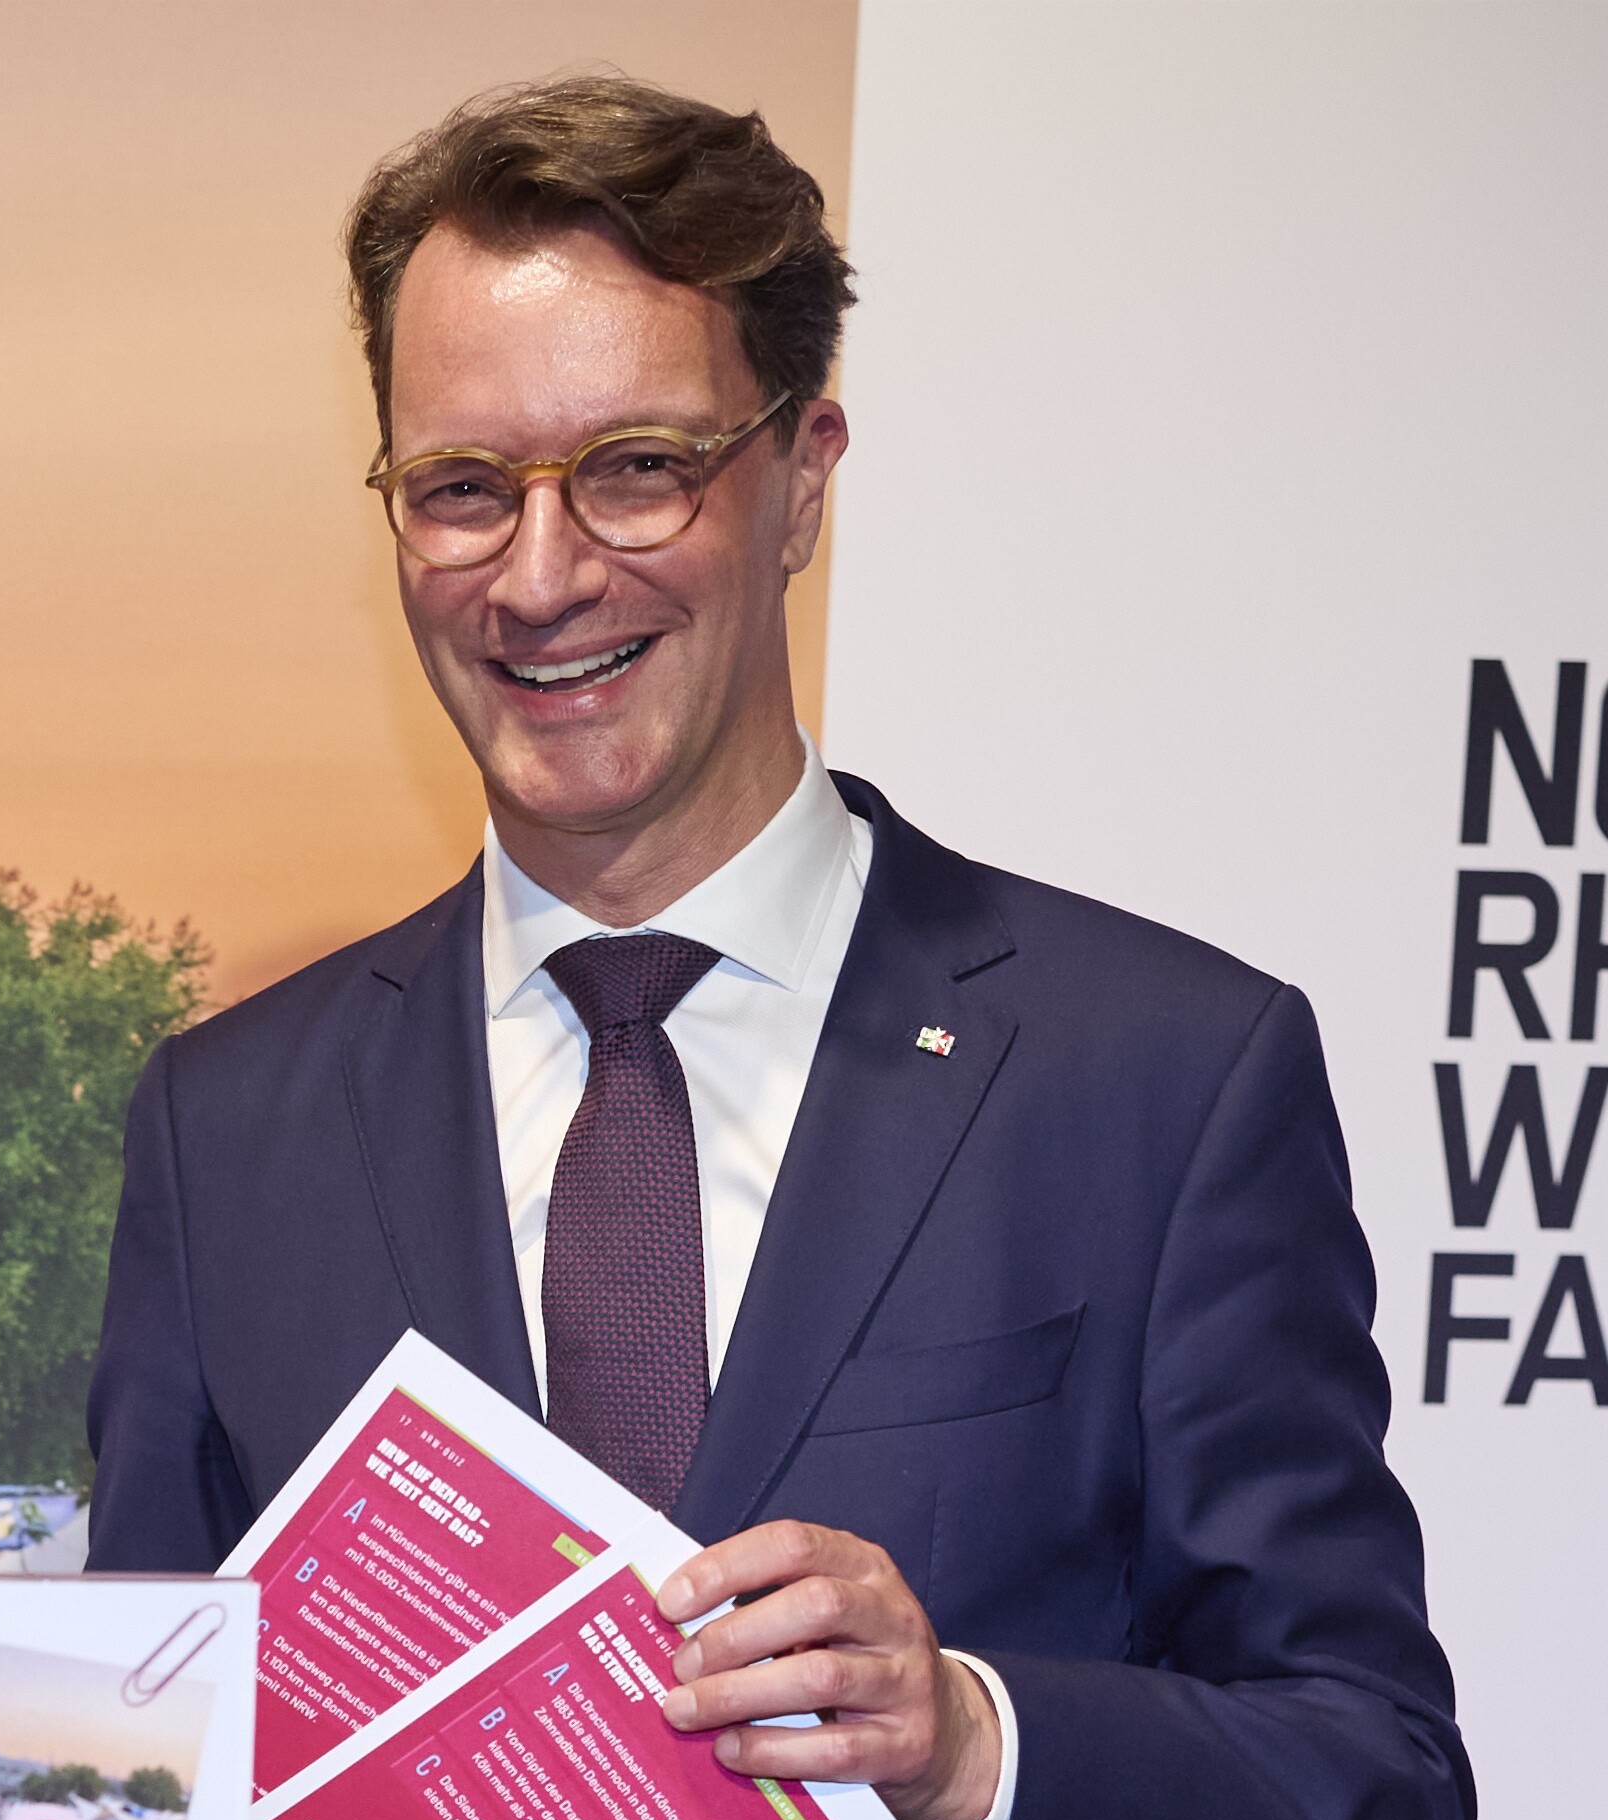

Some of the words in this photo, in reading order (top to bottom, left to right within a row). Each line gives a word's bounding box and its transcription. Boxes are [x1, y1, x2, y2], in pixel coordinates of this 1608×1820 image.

[1460, 658, 1608, 848] N
[365, 1453, 392, 1479] WIE
[388, 1470, 423, 1501] WEIT
[417, 1494, 453, 1524] GEHT
[447, 1516, 483, 1547] DAS?
[376, 1437, 409, 1466] NRW
[403, 1459, 433, 1483] AUF
[427, 1476, 458, 1504] DEM
[452, 1495, 481, 1521] RAD
[342, 1497, 366, 1523] A
[370, 1513, 386, 1530] Im
[384, 1524, 448, 1576] Münsterland
[444, 1572, 468, 1592] gibt
[466, 1588, 481, 1602] es
[479, 1598, 497, 1615] ein
[344, 1547, 365, 1565] mit
[363, 1559, 399, 1590] 15.000
[357, 1531, 442, 1599] ausgeschildertes
[440, 1593, 484, 1630] Radnetz
[294, 1556, 318, 1582] B
[321, 1574, 341, 1593] Die
[339, 1587, 427, 1659] NiederRheinroute
[425, 1653, 441, 1670] ist
[297, 1604, 379, 1672] Radwanderroute
[309, 1589, 327, 1608] km
[326, 1604, 344, 1620] die
[342, 1614, 381, 1648] längste
[592, 1610, 619, 1639] DER
[261, 1650, 289, 1674] 1.100
[286, 1669, 304, 1687] km
[303, 1683, 322, 1702] von
[321, 1696, 349, 1722] Bonn
[273, 1635, 294, 1654] Der
[291, 1649, 332, 1686] Radweg
[577, 1622, 605, 1654] WAS
[598, 1650, 644, 1702] STIMMT?
[278, 1687, 290, 1700] in
[289, 1695, 318, 1722] NRW.
[533, 1705, 587, 1773] Zahnradbahn
[542, 1662, 569, 1686] A
[566, 1681, 584, 1702] Die
[580, 1699, 647, 1783] Drachenfelsbahn
[643, 1780, 655, 1794] in
[415, 1754, 441, 1776] C
[438, 1774, 457, 1797] Das
[471, 1751, 492, 1777] Köln
[489, 1775, 513, 1802] mehr
[509, 1802, 525, 1818] als
[479, 1706, 505, 1730] B
[504, 1728, 525, 1754] Vom
[521, 1751, 550, 1784] Gipfel
[544, 1782, 562, 1802] des
[487, 1739, 517, 1777] klarem
[514, 1773, 545, 1809] Wetter
[551, 1694, 574, 1719] 1883
[568, 1718, 584, 1736] die
[580, 1733, 611, 1770] älteste
[607, 1769, 630, 1796] noch
[626, 1792, 639, 1807] in
[423, 1787, 452, 1820] sieben
